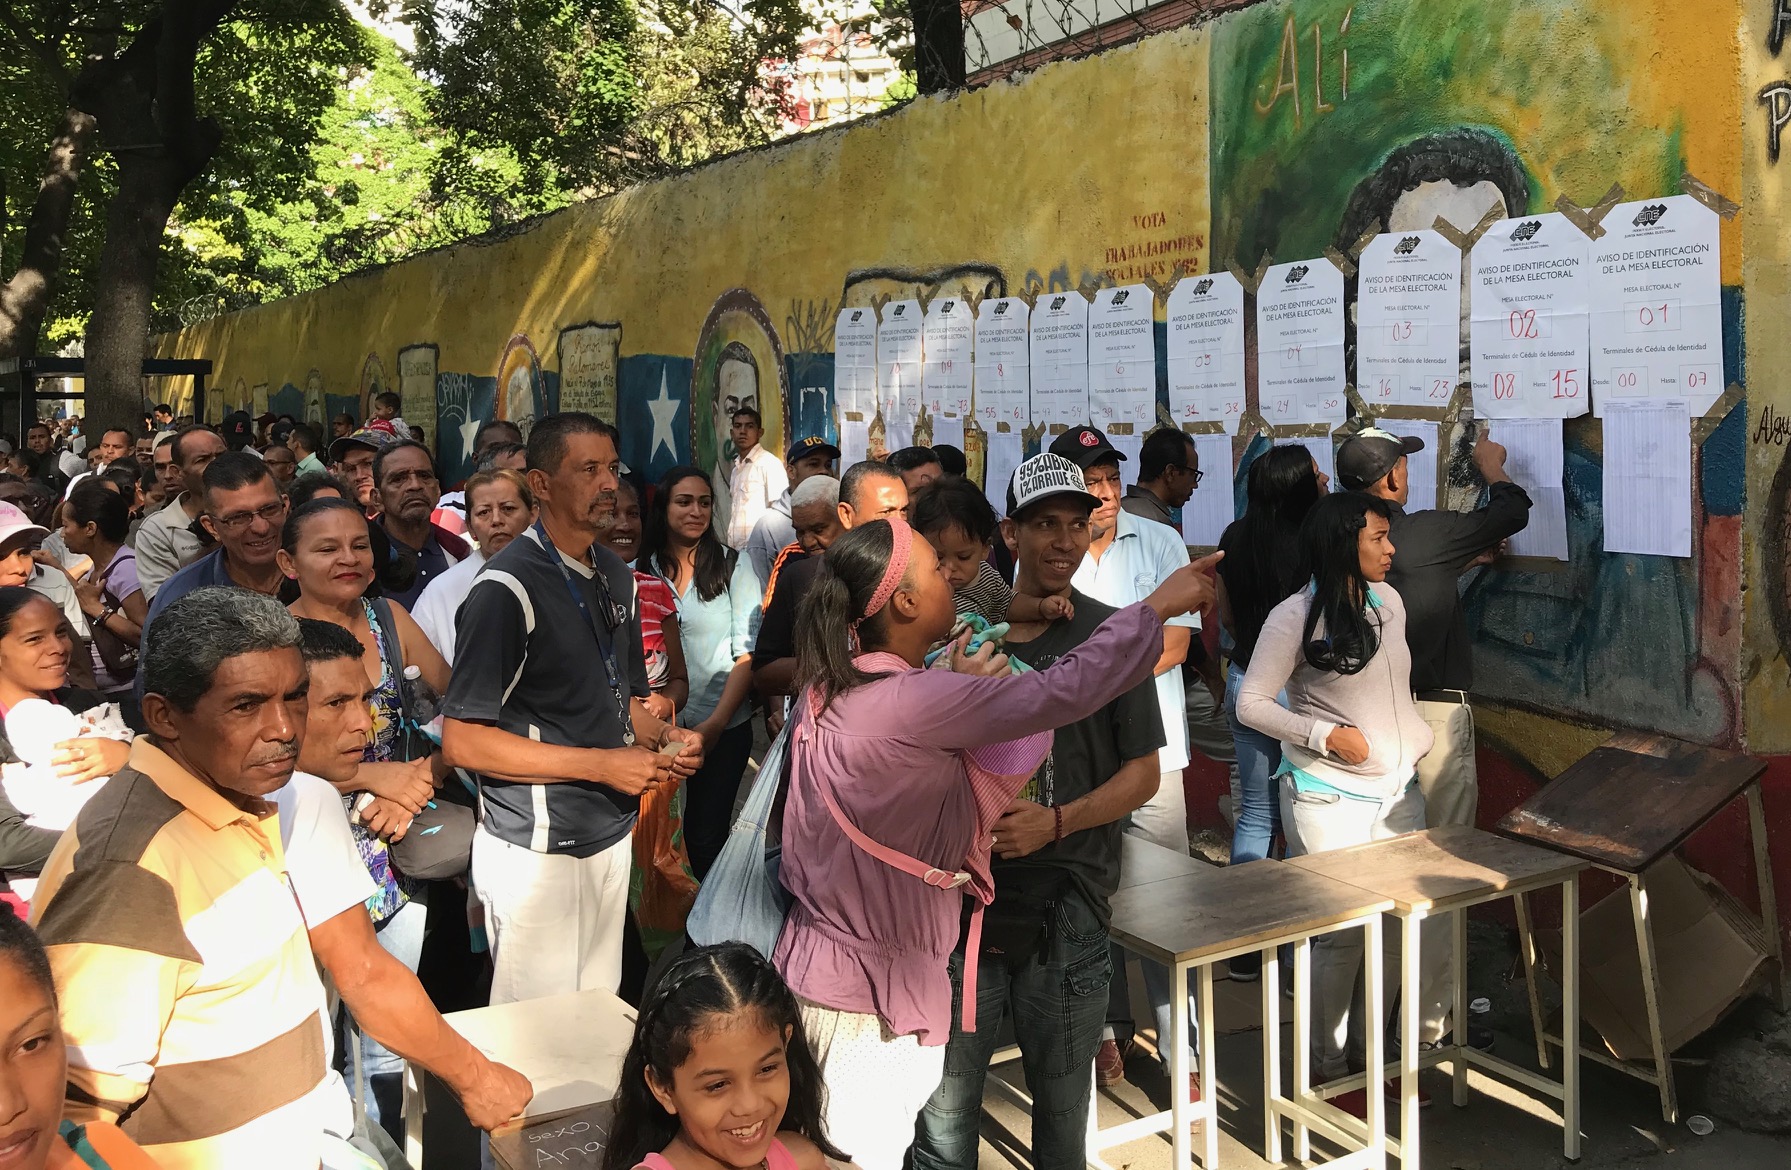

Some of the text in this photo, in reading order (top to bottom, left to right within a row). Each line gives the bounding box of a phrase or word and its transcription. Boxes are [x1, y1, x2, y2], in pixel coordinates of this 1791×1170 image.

[1132, 211, 1166, 229] VOTA
[1596, 243, 1709, 263] AVISO DE IDENTIFICACIÓN
[1105, 260, 1165, 280] SOCIALES
[1477, 257, 1579, 276] AVISO DE IDENTIFICACIÓN
[1602, 257, 1703, 274] DE LA MESA ELECTORAL
[1365, 276, 1384, 284] AVISO
[1395, 272, 1453, 282] IDENTIFICACIÓN
[1483, 270, 1573, 286] DE LA MESA ELECTORAL
[1407, 283, 1447, 292] ELECTORAL
[1640, 283, 1672, 292] ELECTORAL
[1262, 296, 1337, 313] AVISO DE IDENTIFICACIÓN
[1515, 294, 1545, 302] ELECTORAL
[1195, 308, 1238, 319] IDENTIFICACIÓN
[1274, 313, 1282, 321] LA
[1297, 307, 1332, 318] ELECTORAL
[1640, 303, 1668, 325] 01
[1204, 318, 1234, 327] ELECTORAL
[1510, 309, 1538, 339] 02
[1120, 327, 1146, 336] ELECTORAL
[1393, 321, 1412, 341] 03
[1287, 344, 1302, 361] 04
[1519, 351, 1538, 359] Cédula
[1602, 347, 1634, 355] Terminales
[1644, 345, 1666, 353] Cédula
[1677, 343, 1707, 351] Identidad
[941, 359, 952, 374] 09
[997, 363, 1003, 377] 8
[1116, 359, 1125, 375] 6
[1494, 373, 1515, 400] 08
[1552, 369, 1579, 398] 15
[1618, 372, 1636, 387] 00
[1688, 371, 1707, 387] 07
[1379, 379, 1391, 397] 16
[1429, 379, 1449, 398] 23
[958, 399, 968, 412] 73
[985, 406, 1024, 419] 55 61
[1071, 405, 1082, 418] 54
[1102, 403, 1146, 419] 39 46
[1185, 402, 1239, 417] 31 38
[1277, 399, 1338, 413] 24 30
